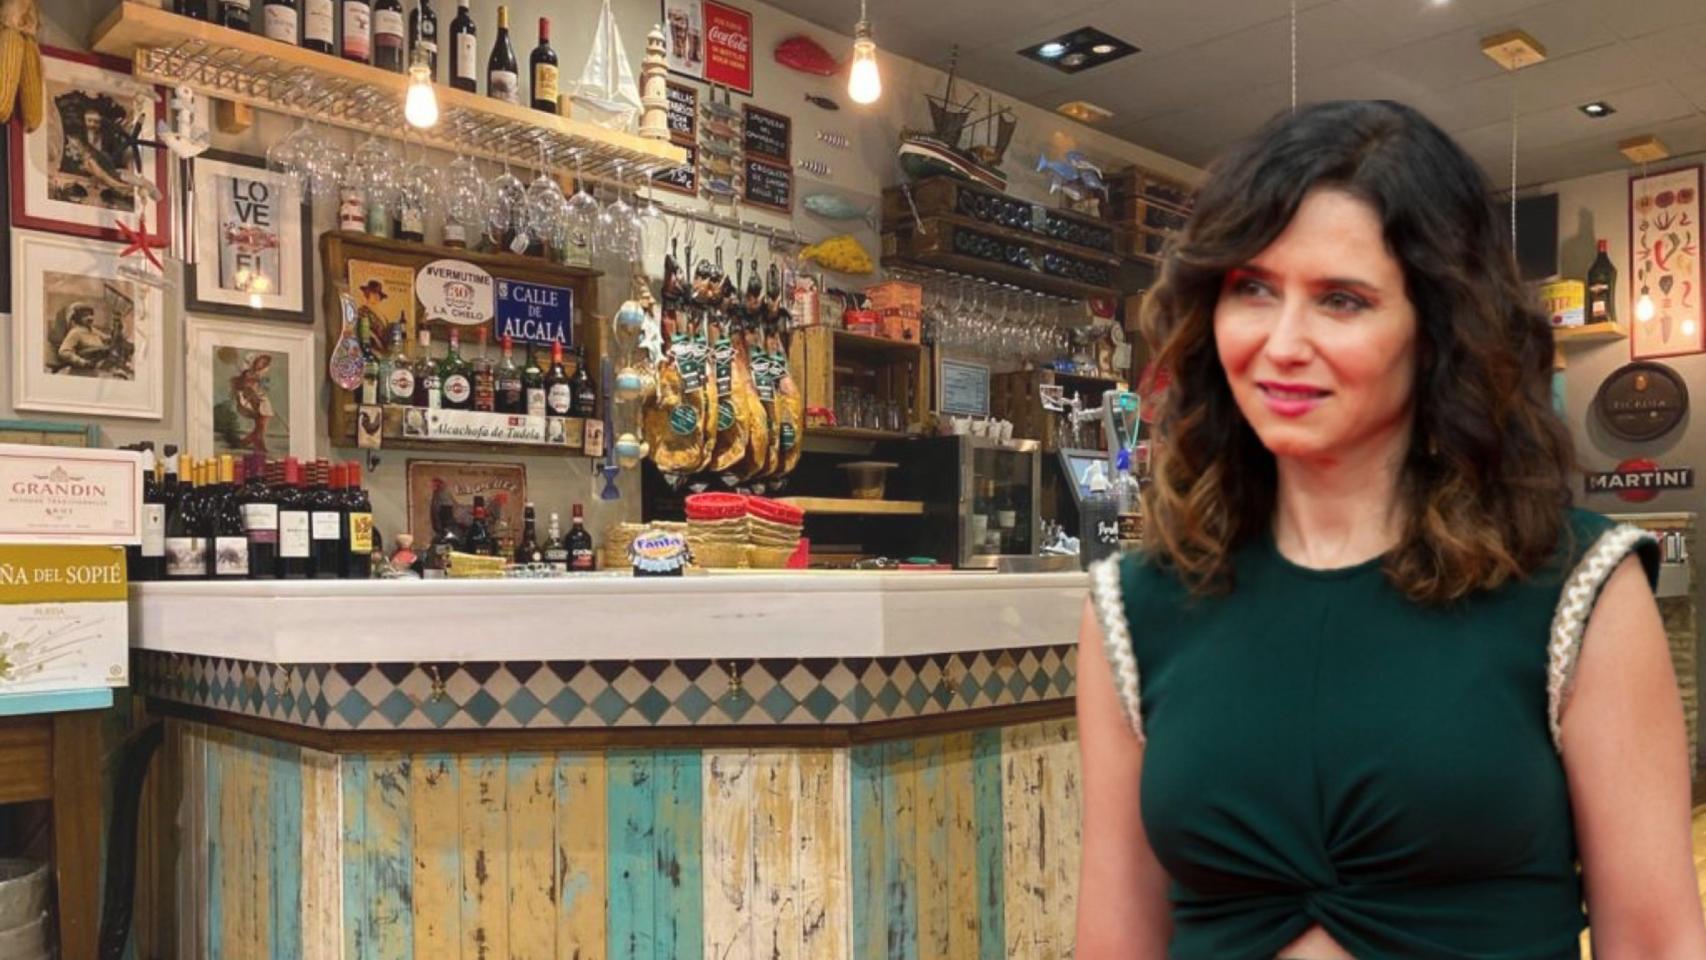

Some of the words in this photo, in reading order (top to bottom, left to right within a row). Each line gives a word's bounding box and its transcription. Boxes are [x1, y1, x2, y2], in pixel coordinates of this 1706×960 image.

[232, 178, 268, 202] LO
[235, 201, 270, 226] VE
[426, 266, 491, 286] #VERMUTIME
[513, 286, 559, 307] CALLE
[433, 305, 447, 316] LA
[451, 308, 485, 321] CHELO
[528, 305, 542, 318] DE
[504, 319, 566, 343] ALCALÁ
[433, 423, 489, 439] Alcachofa
[490, 425, 502, 438] de
[505, 428, 541, 440] Tudela
[12, 481, 106, 497] GRANDIN
[1589, 470, 1688, 489] MARTINI
[637, 533, 682, 550] Fanta
[0, 563, 29, 586] ÑA
[33, 567, 63, 583] DEL
[65, 562, 122, 584] SOPIÉ
